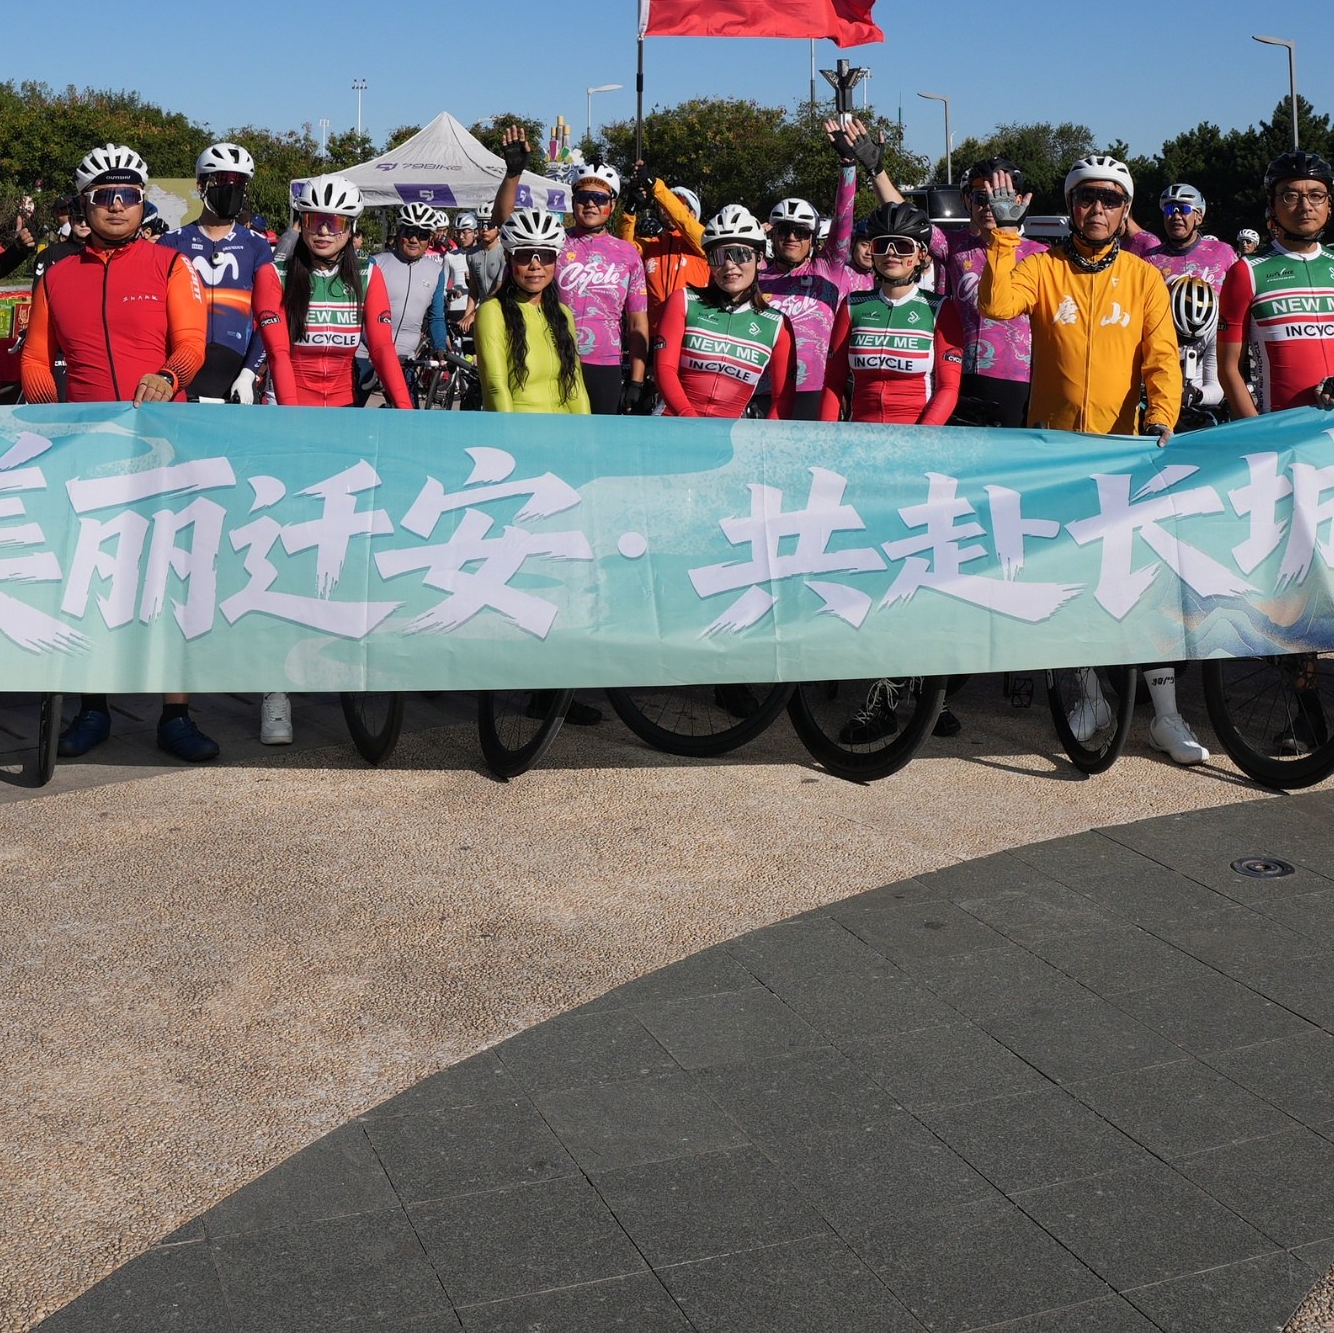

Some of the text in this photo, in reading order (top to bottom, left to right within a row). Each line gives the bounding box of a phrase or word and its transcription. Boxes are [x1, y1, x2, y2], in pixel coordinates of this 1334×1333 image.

[558, 262, 620, 295] Cycle
[1052, 295, 1131, 328] 唐山
[1271, 298, 1323, 314] NEW
[304, 310, 357, 324] EW ME
[299, 333, 356, 345] NCYCLE
[855, 335, 919, 349] NEW ME
[689, 336, 759, 363] NEW ME
[689, 359, 751, 381] INCYCLE
[854, 356, 913, 371] INCYCLE
